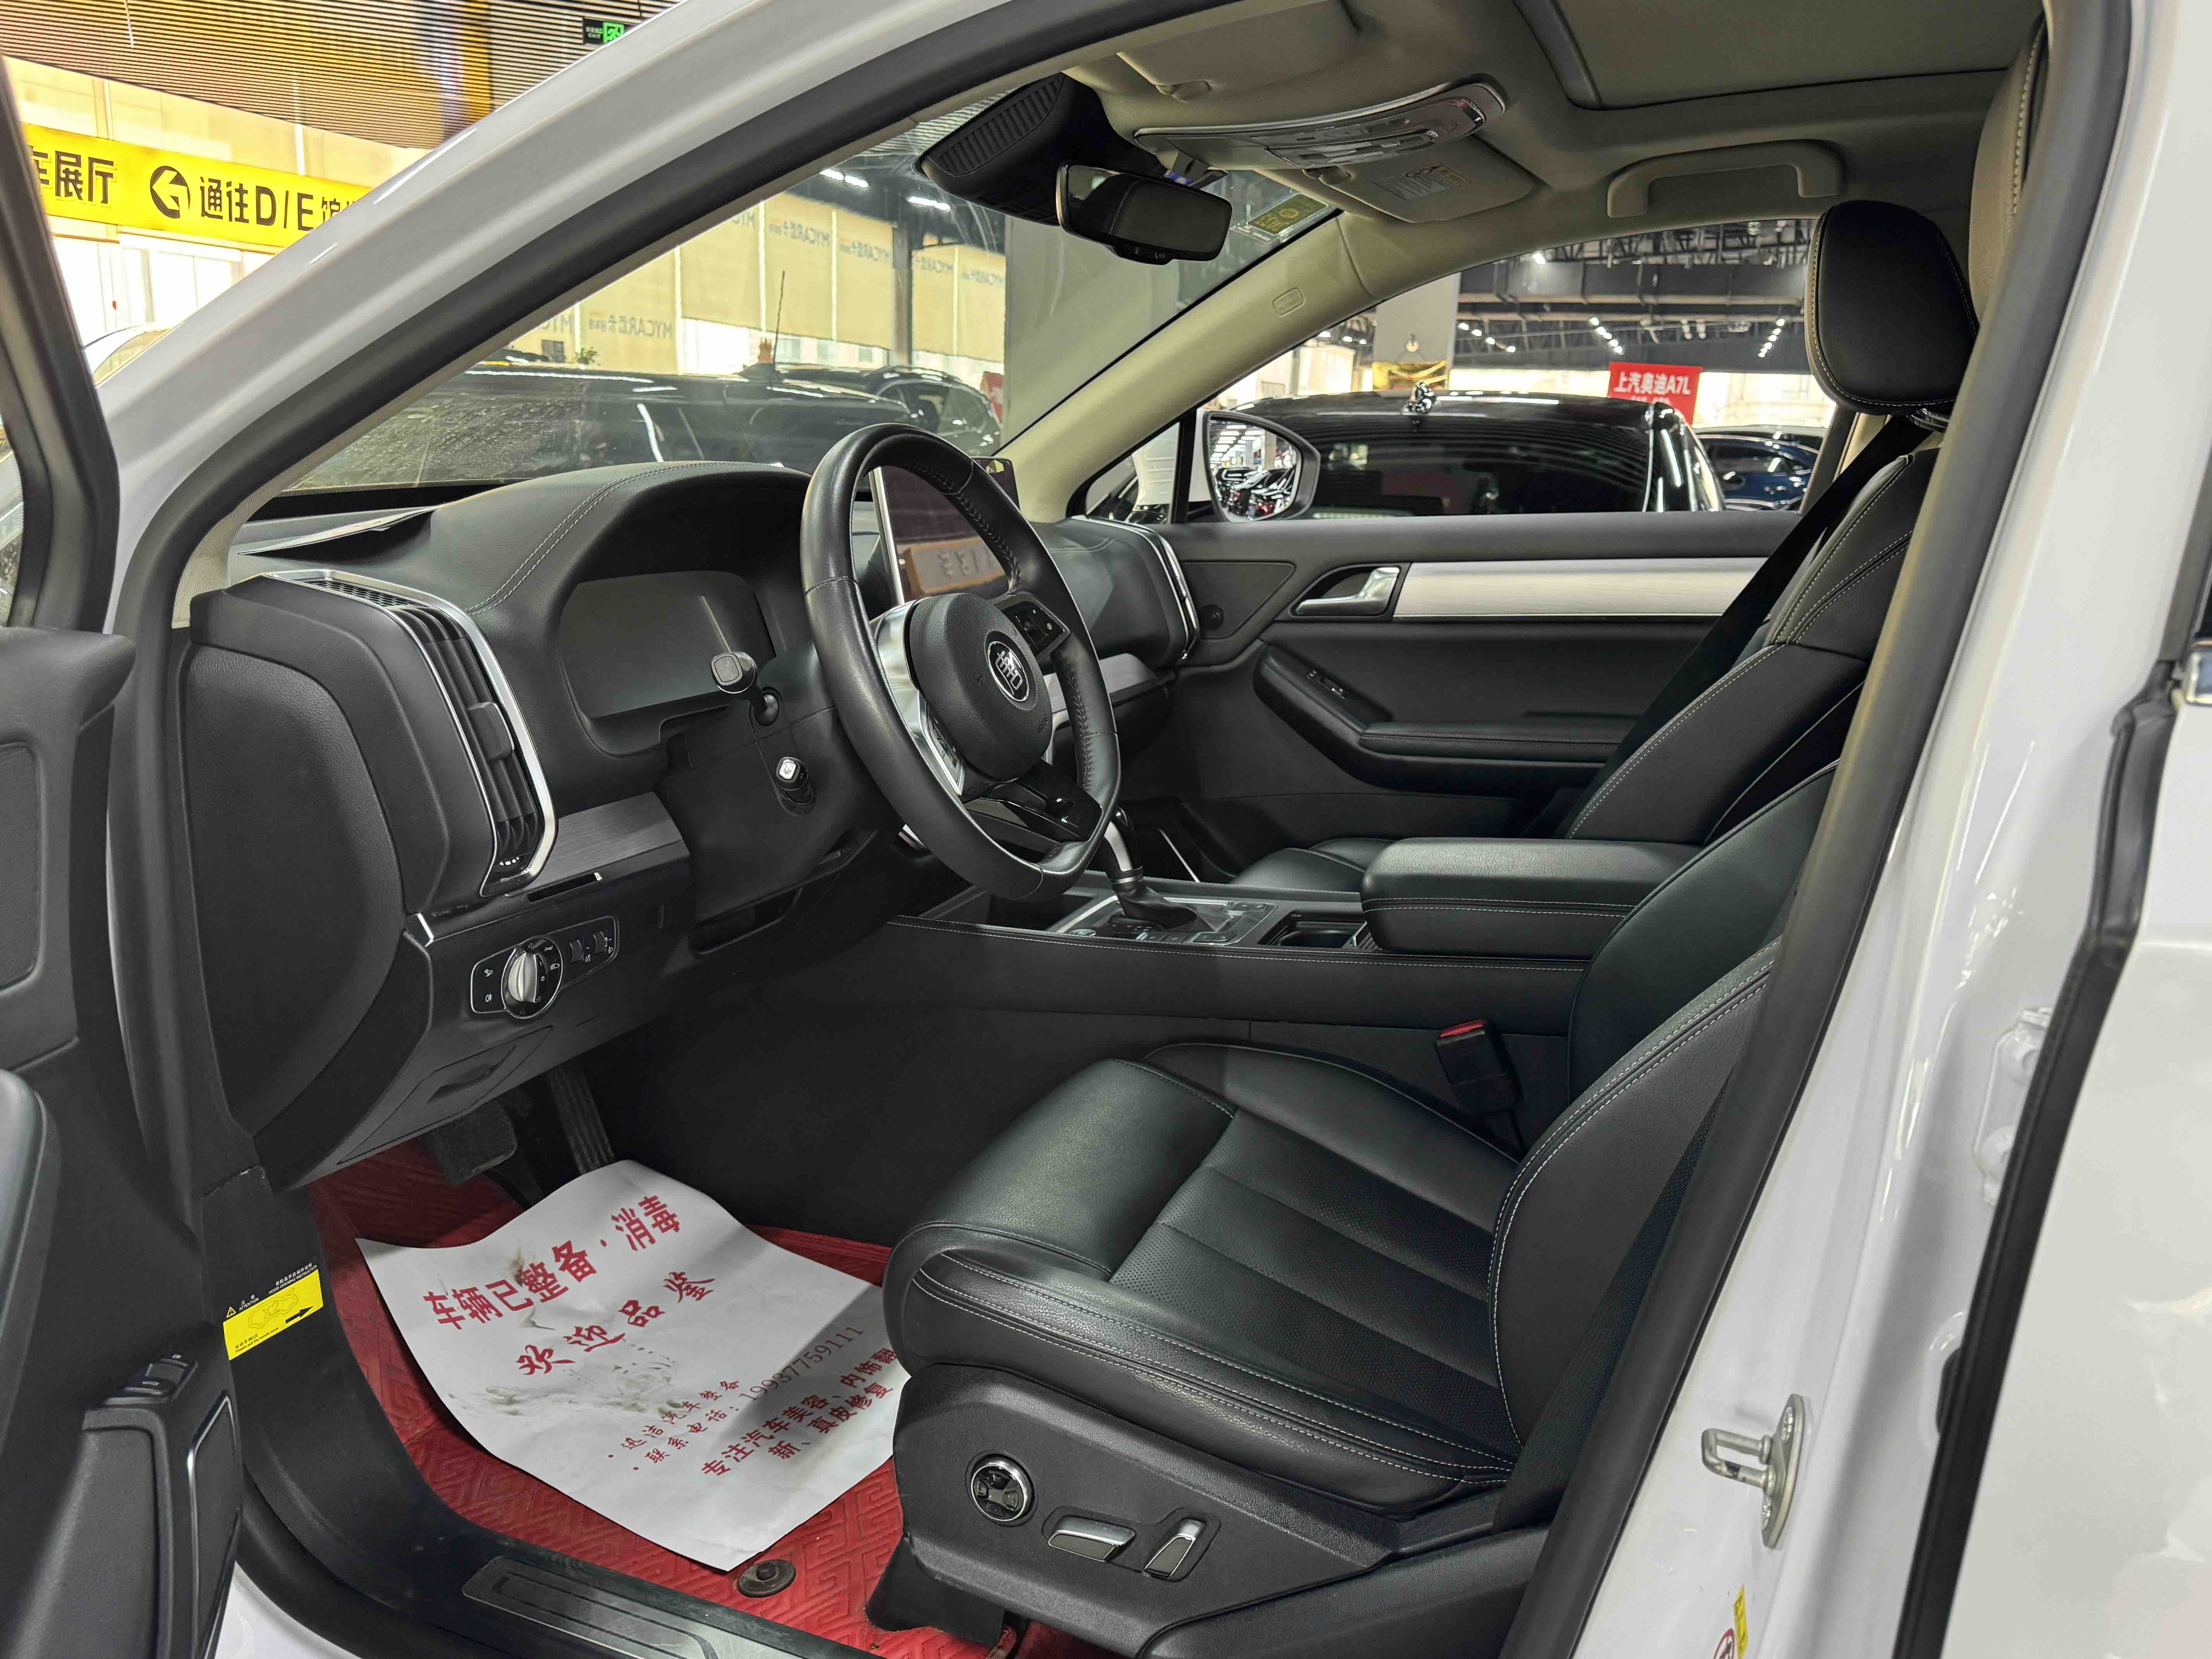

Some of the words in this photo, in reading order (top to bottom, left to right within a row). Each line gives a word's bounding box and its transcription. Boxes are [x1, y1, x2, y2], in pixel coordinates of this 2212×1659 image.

[1613, 372, 1691, 395] 上汽奥迪A7L
[280, 1278, 296, 1288] OPENING
[239, 1297, 259, 1311] ATTENTION
[515, 1271, 714, 1375] 欢迎品鉴
[768, 1382, 893, 1459] 新、真皮修复
